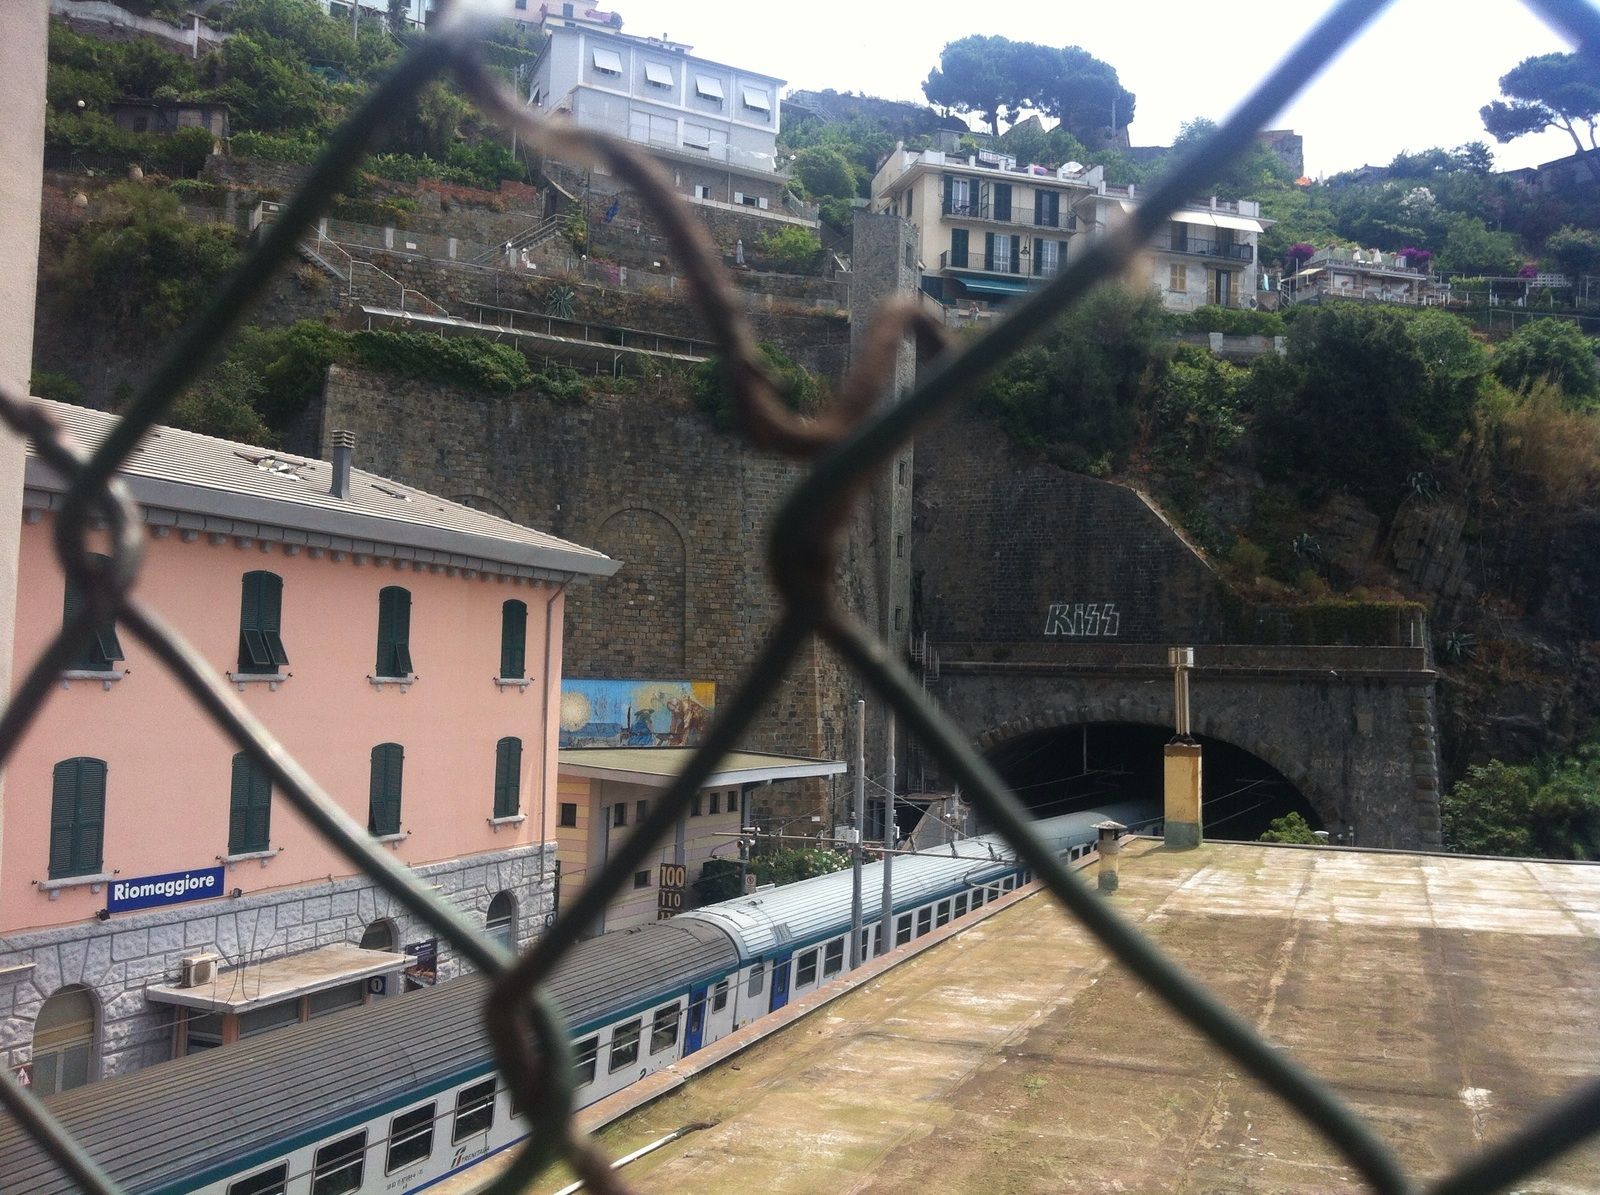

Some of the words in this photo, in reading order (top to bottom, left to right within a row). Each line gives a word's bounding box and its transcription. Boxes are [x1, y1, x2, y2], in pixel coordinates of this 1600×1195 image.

[661, 866, 685, 888] 100
[114, 874, 215, 901] Riomaggiore
[661, 892, 681, 907] 110
[638, 1067, 647, 1081] 2
